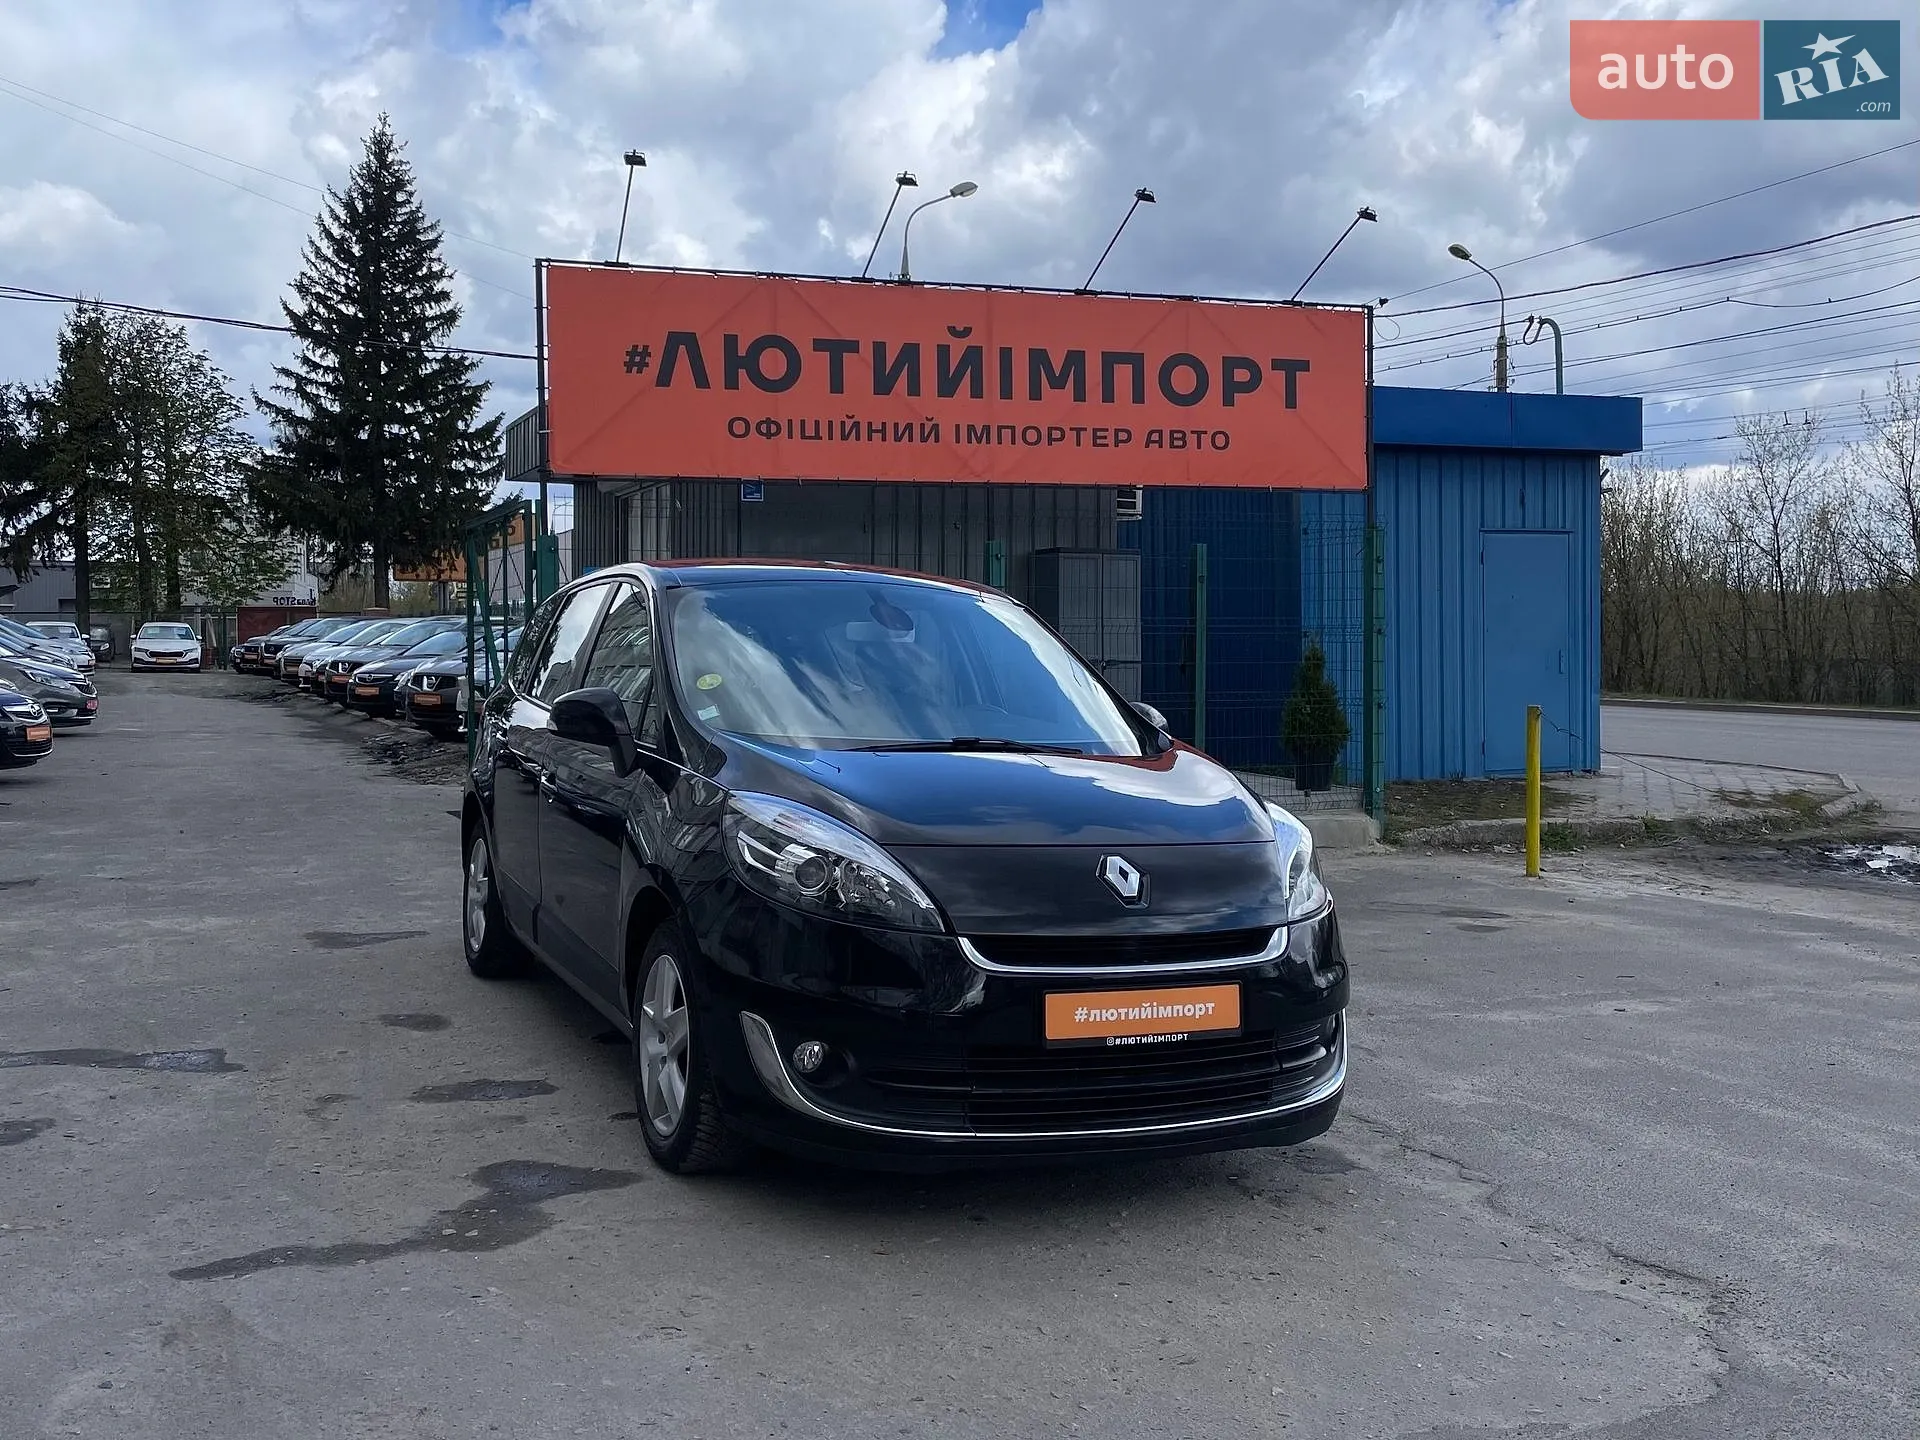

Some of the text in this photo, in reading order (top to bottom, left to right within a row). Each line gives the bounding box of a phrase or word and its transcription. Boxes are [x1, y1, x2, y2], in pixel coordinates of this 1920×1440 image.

[622, 324, 1311, 410] #ЛЮТИЙІМПОРТ
[727, 413, 1231, 451] ОФІЦІЙНИЙ ІМПОРТЕР АВТО
[1074, 1002, 1216, 1023] #лютийімпорт
